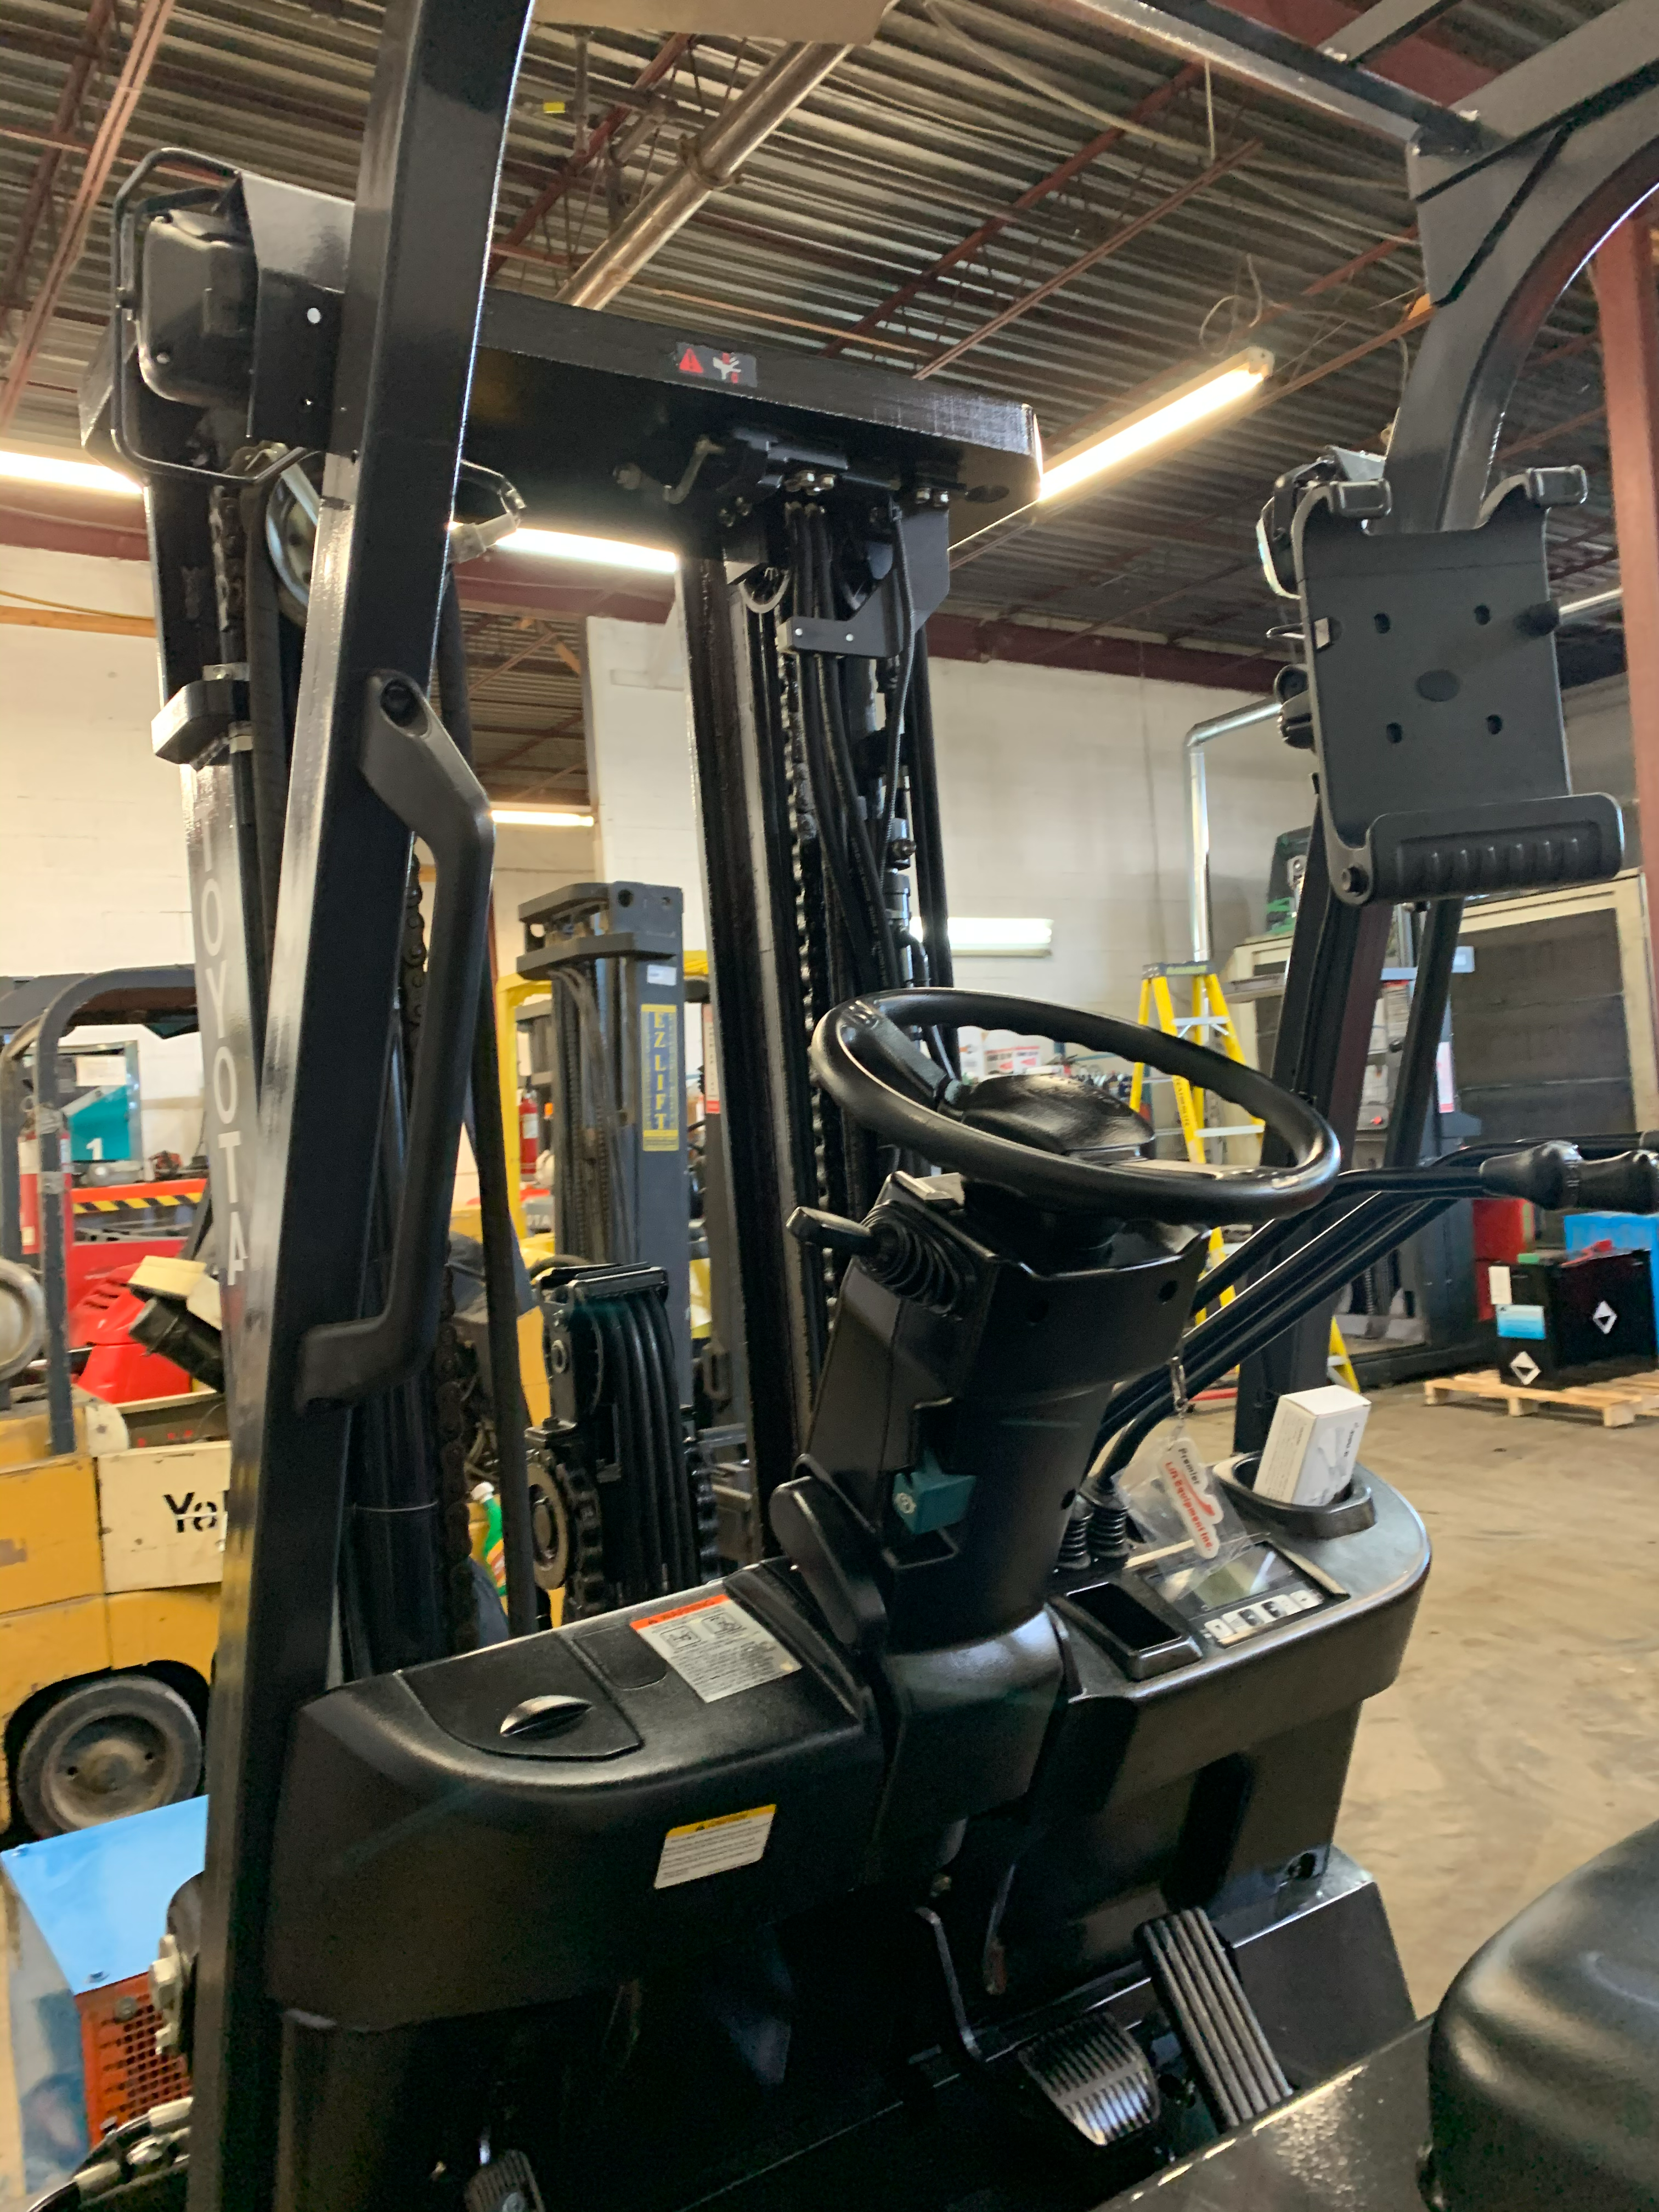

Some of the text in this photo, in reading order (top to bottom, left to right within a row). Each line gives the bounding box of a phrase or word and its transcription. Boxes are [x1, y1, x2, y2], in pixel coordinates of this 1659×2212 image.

[195, 799, 249, 1286] TOYOTA
[653, 1012, 666, 1048] EZ
[654, 1054, 667, 1130] LIFT
[1178, 1447, 1200, 1485] Premier
[1165, 1461, 1214, 1551] Lift Equipment Inc.
